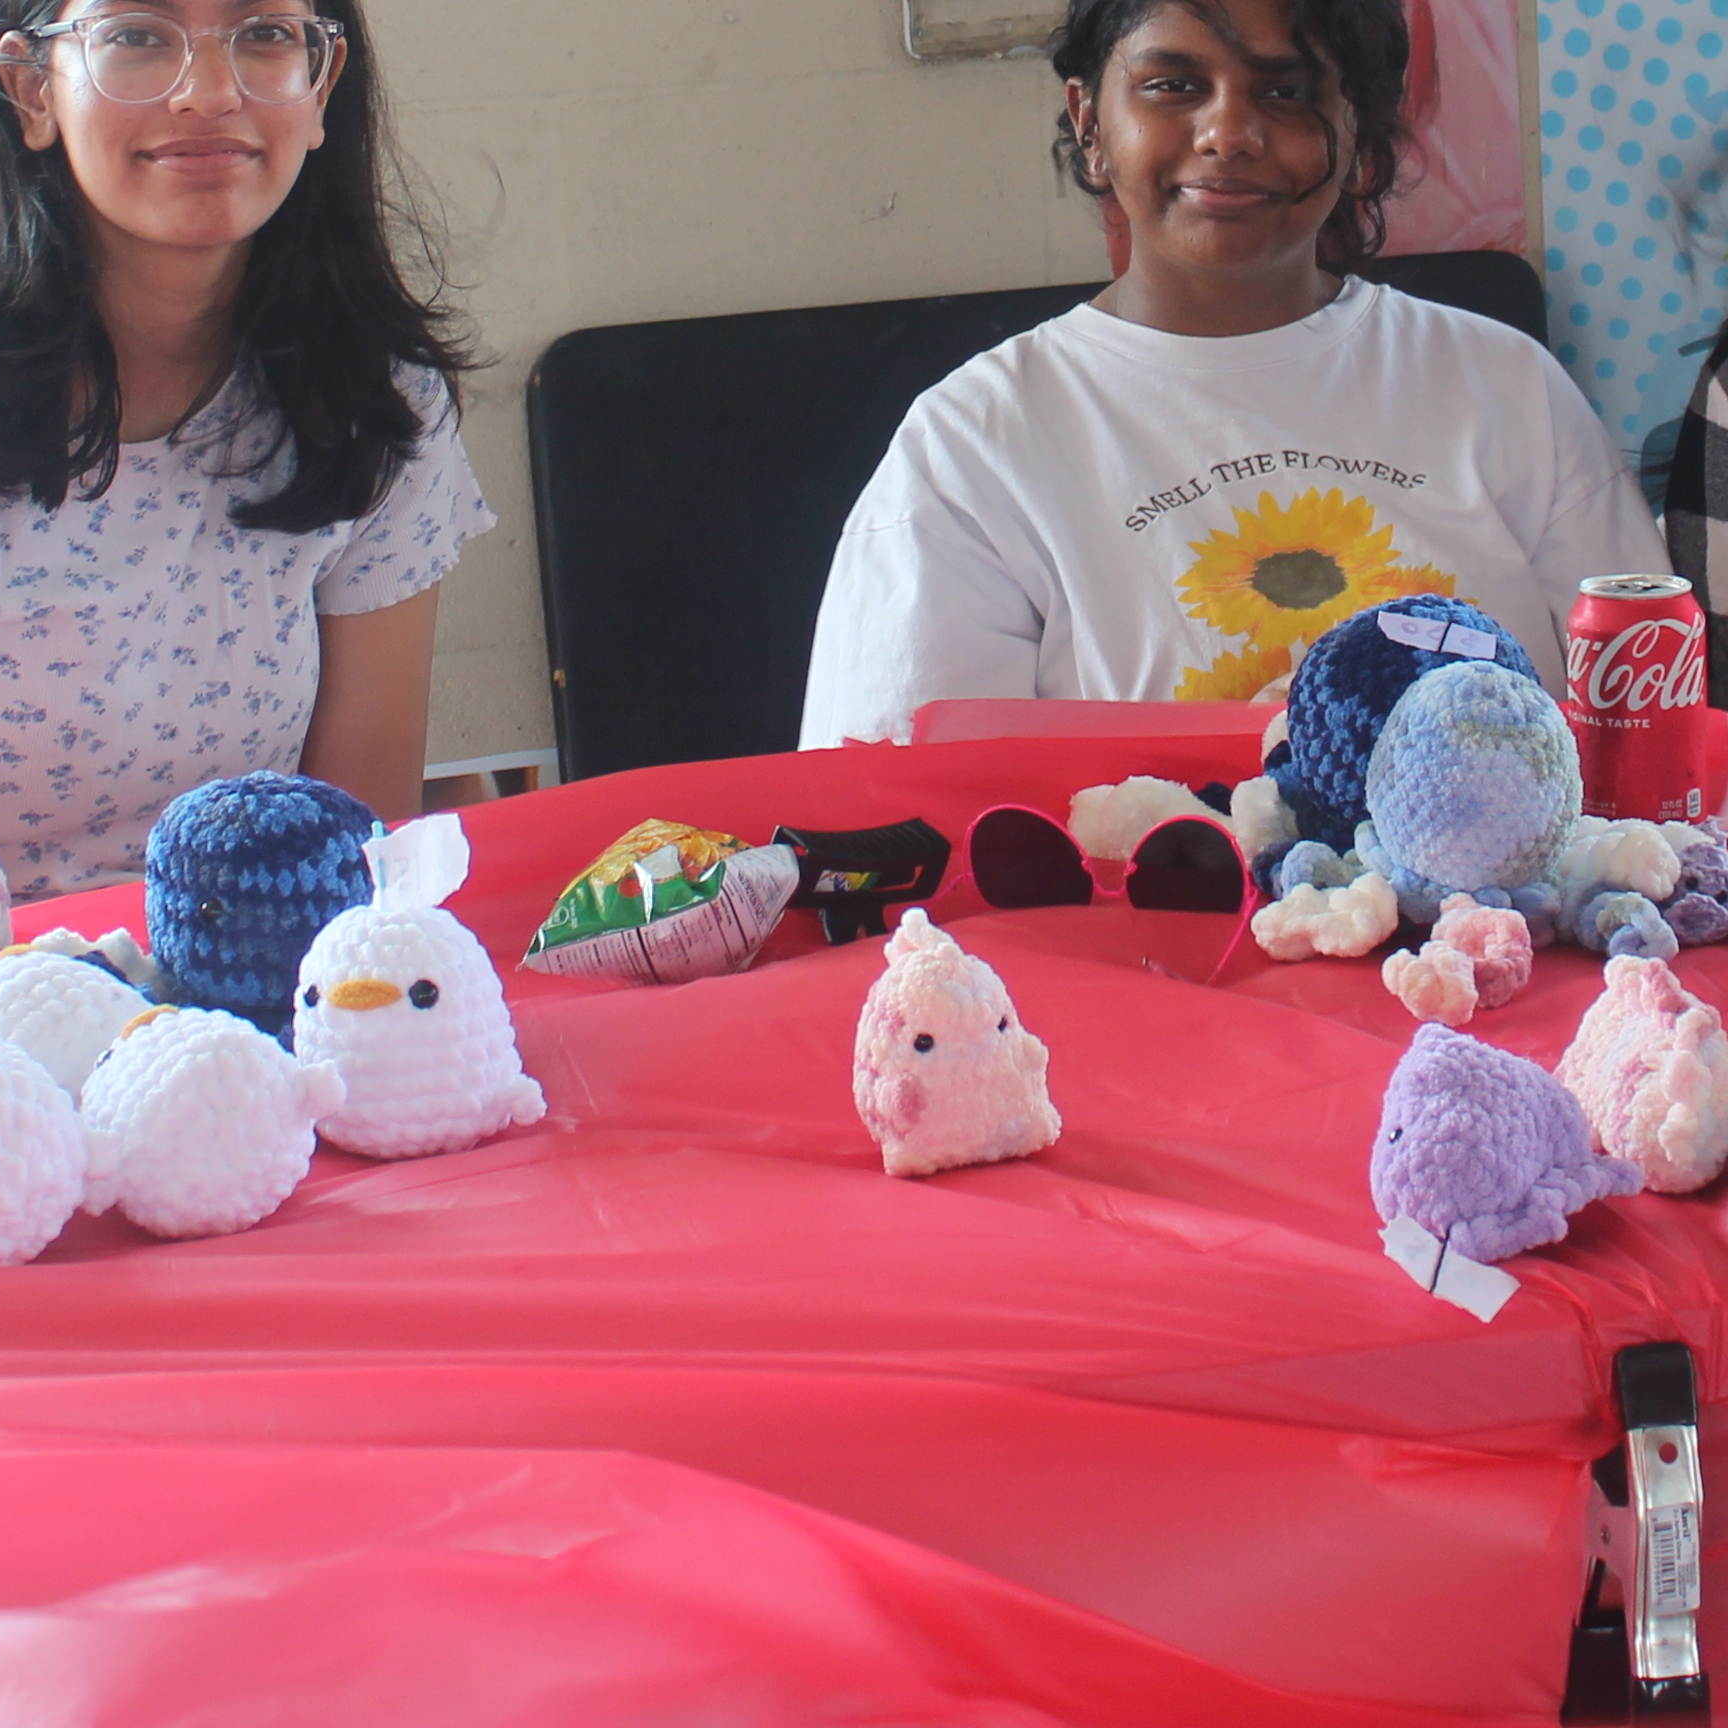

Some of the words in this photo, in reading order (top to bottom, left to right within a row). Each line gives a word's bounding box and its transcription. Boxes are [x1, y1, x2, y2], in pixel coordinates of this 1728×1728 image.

[1125, 477, 1212, 532] SMELL
[1210, 454, 1277, 484] THE
[1282, 450, 1427, 489] FLOWERS
[1567, 612, 1706, 711] a-Cola
[1607, 718, 1650, 729] TASTE
